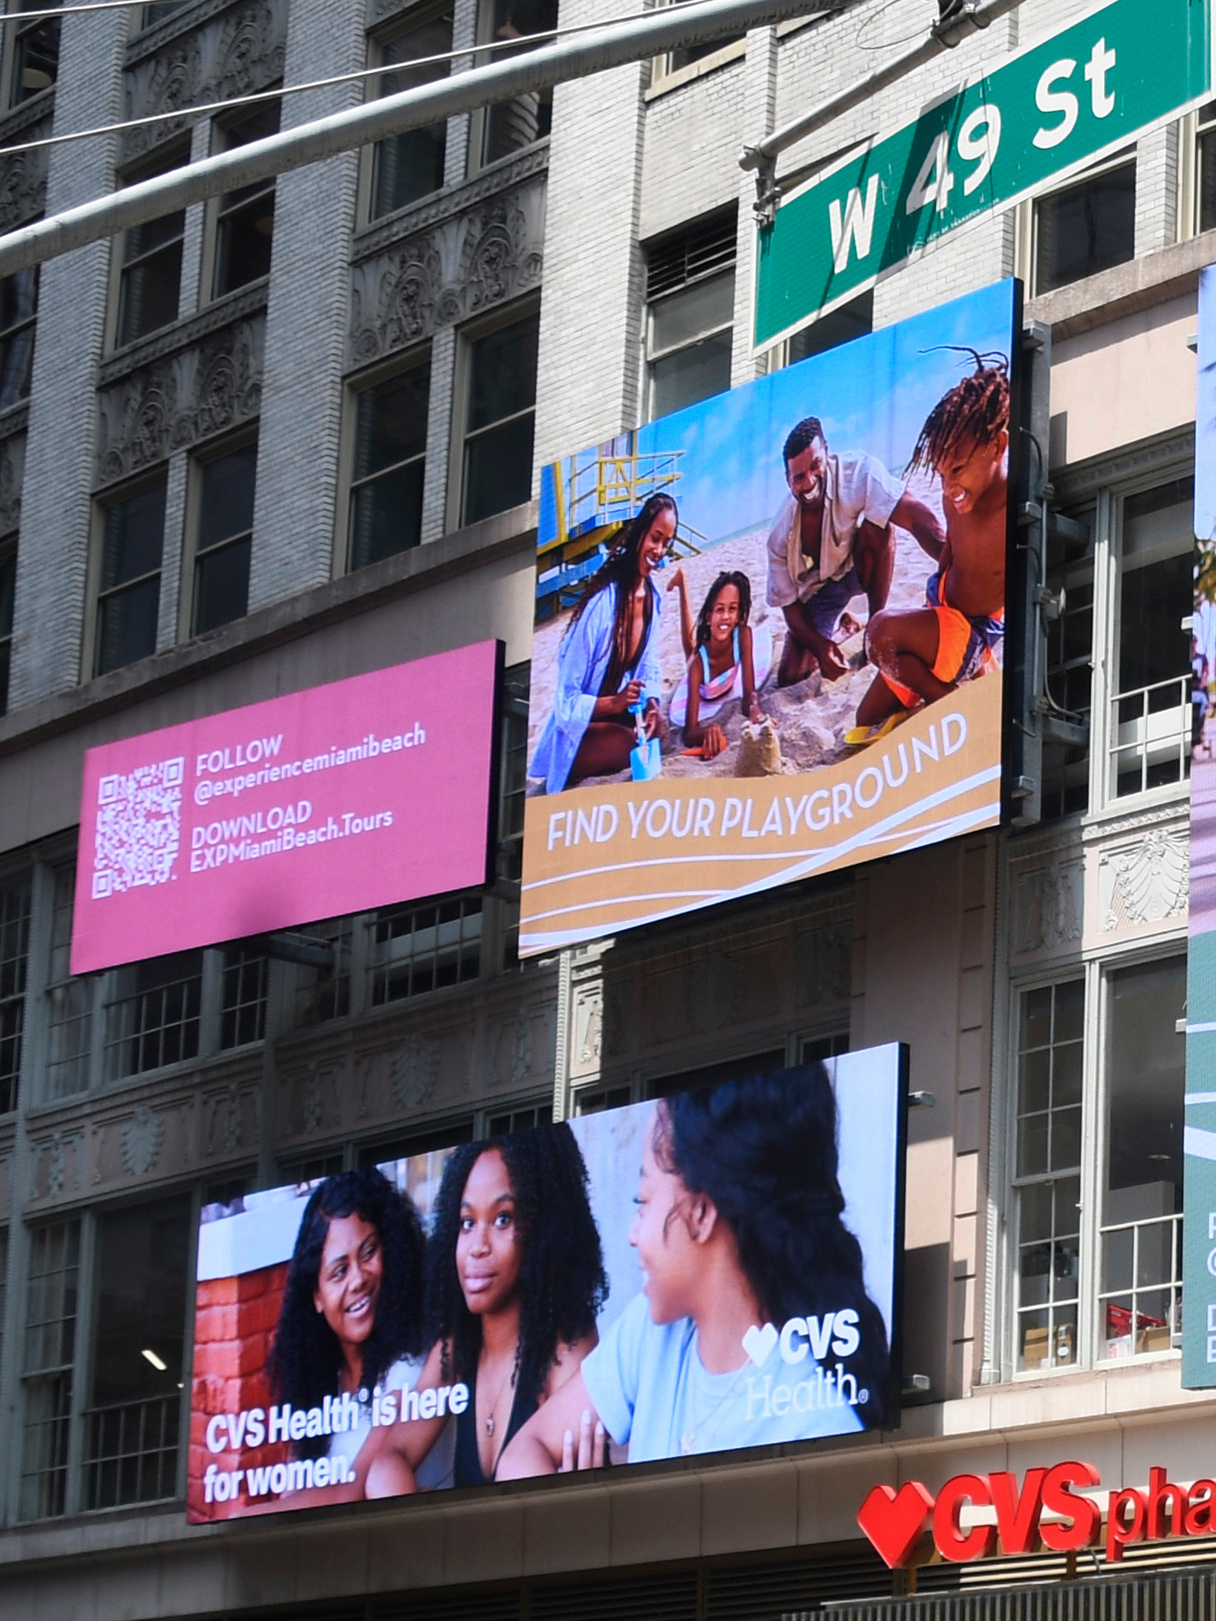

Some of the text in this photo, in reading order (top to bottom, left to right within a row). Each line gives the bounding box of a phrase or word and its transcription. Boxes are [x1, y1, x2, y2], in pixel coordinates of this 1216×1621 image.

[829, 37, 1116, 275] W 49 St
[194, 722, 426, 805] @experiencemiamibeach
[196, 734, 284, 777] FOLLOW
[547, 711, 968, 851] FIND YOUR PLAYGROUND
[189, 808, 394, 873] EXPMiamiBeach.Tours
[192, 800, 312, 849] DOWNLOAD
[779, 1308, 860, 1365] CVS
[206, 1408, 265, 1454] CVS
[372, 1386, 397, 1427] is
[401, 1381, 469, 1423] here
[203, 1454, 356, 1503] for women.
[932, 1461, 1100, 1561] CVS
